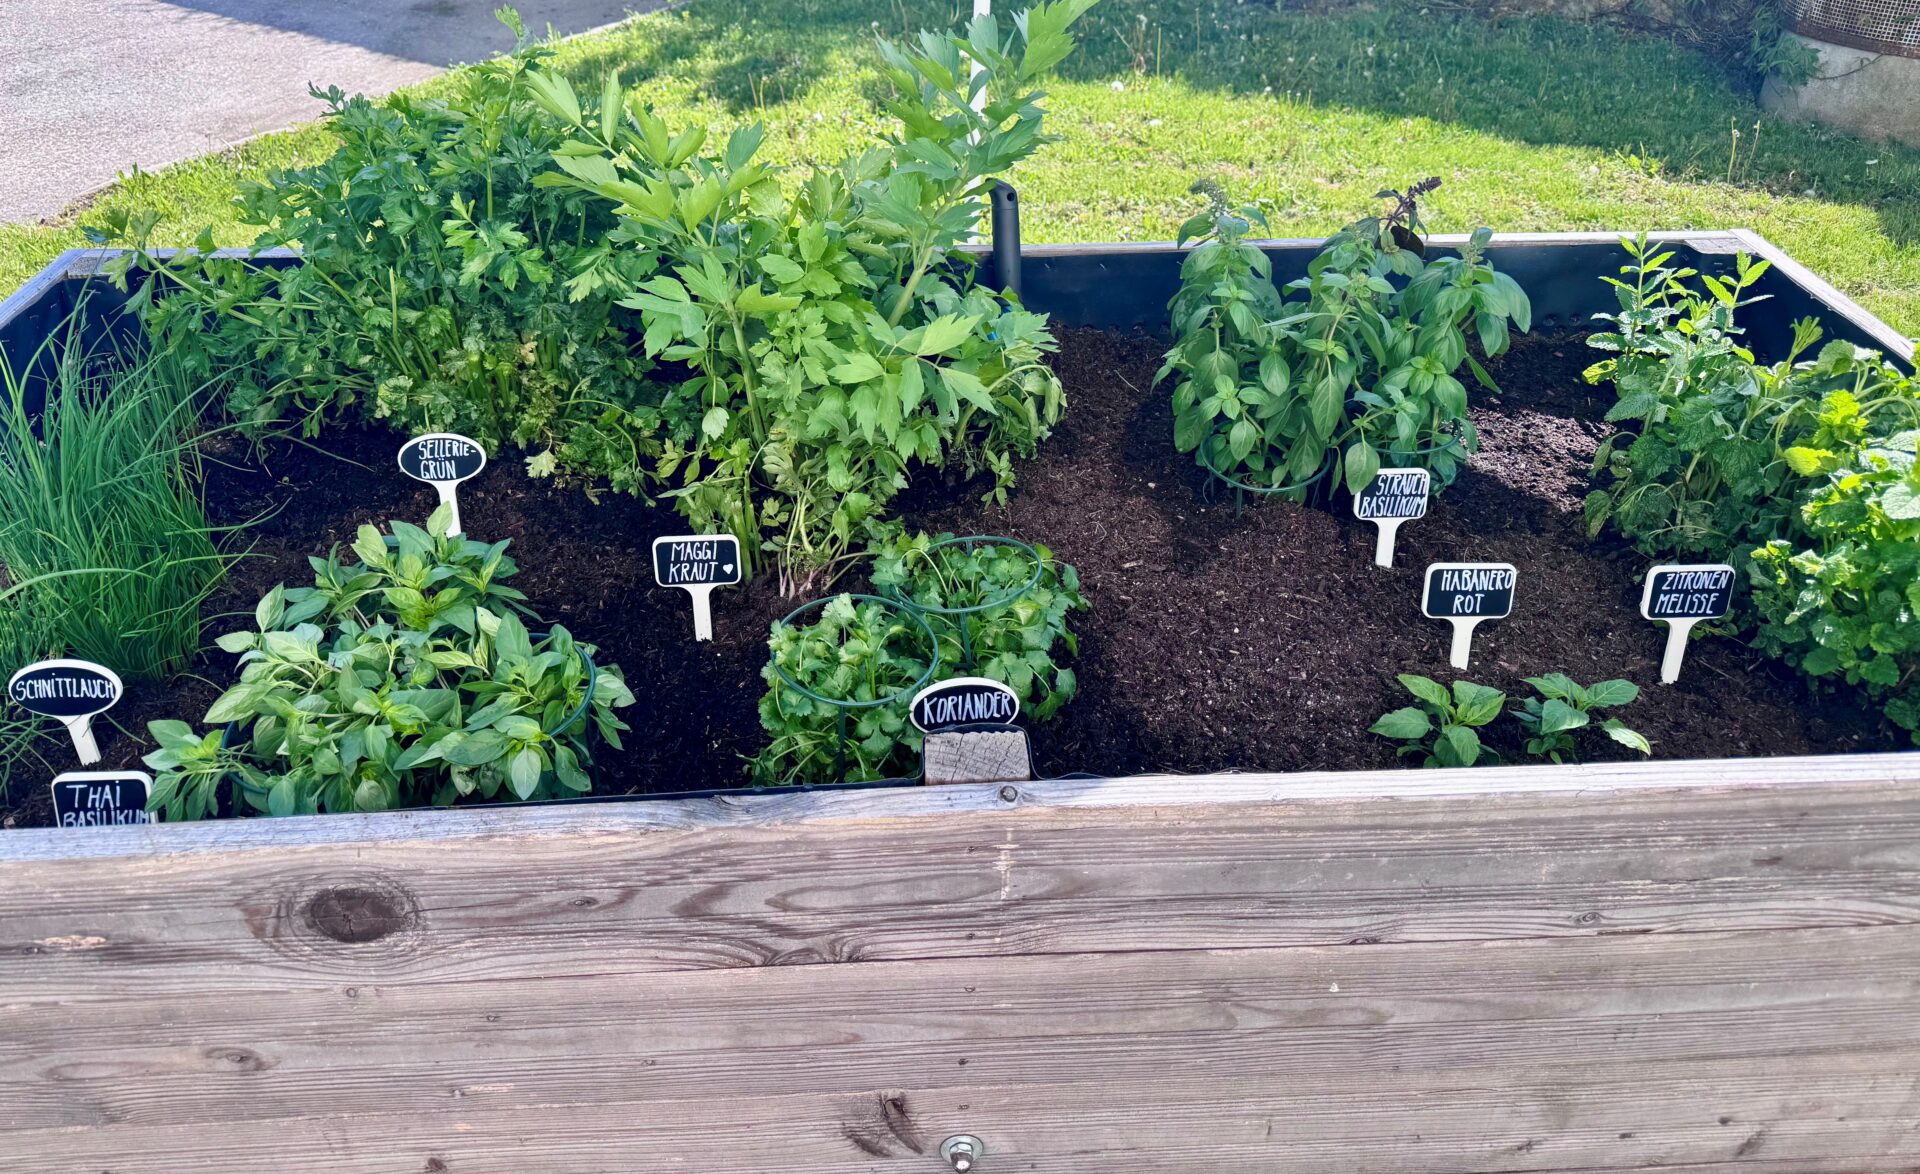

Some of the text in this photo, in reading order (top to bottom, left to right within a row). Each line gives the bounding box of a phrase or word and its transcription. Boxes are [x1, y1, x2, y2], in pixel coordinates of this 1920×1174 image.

[418, 439, 477, 460] SELLERIE-
[420, 458, 457, 480] GRÜN
[1375, 473, 1427, 496] STRAUCH
[1360, 494, 1427, 517] BASILIKUM
[671, 540, 718, 562] MAGGI
[668, 561, 719, 584] KRAUT
[1441, 569, 1514, 592] HABANERO
[1661, 570, 1731, 590] ZITRONEN
[1452, 593, 1485, 614] ROT
[1654, 589, 1719, 614] MELISSE
[15, 672, 116, 701] SCHNITTLAUCH
[923, 691, 1012, 726] KORIANDER
[65, 780, 121, 809] THAI
